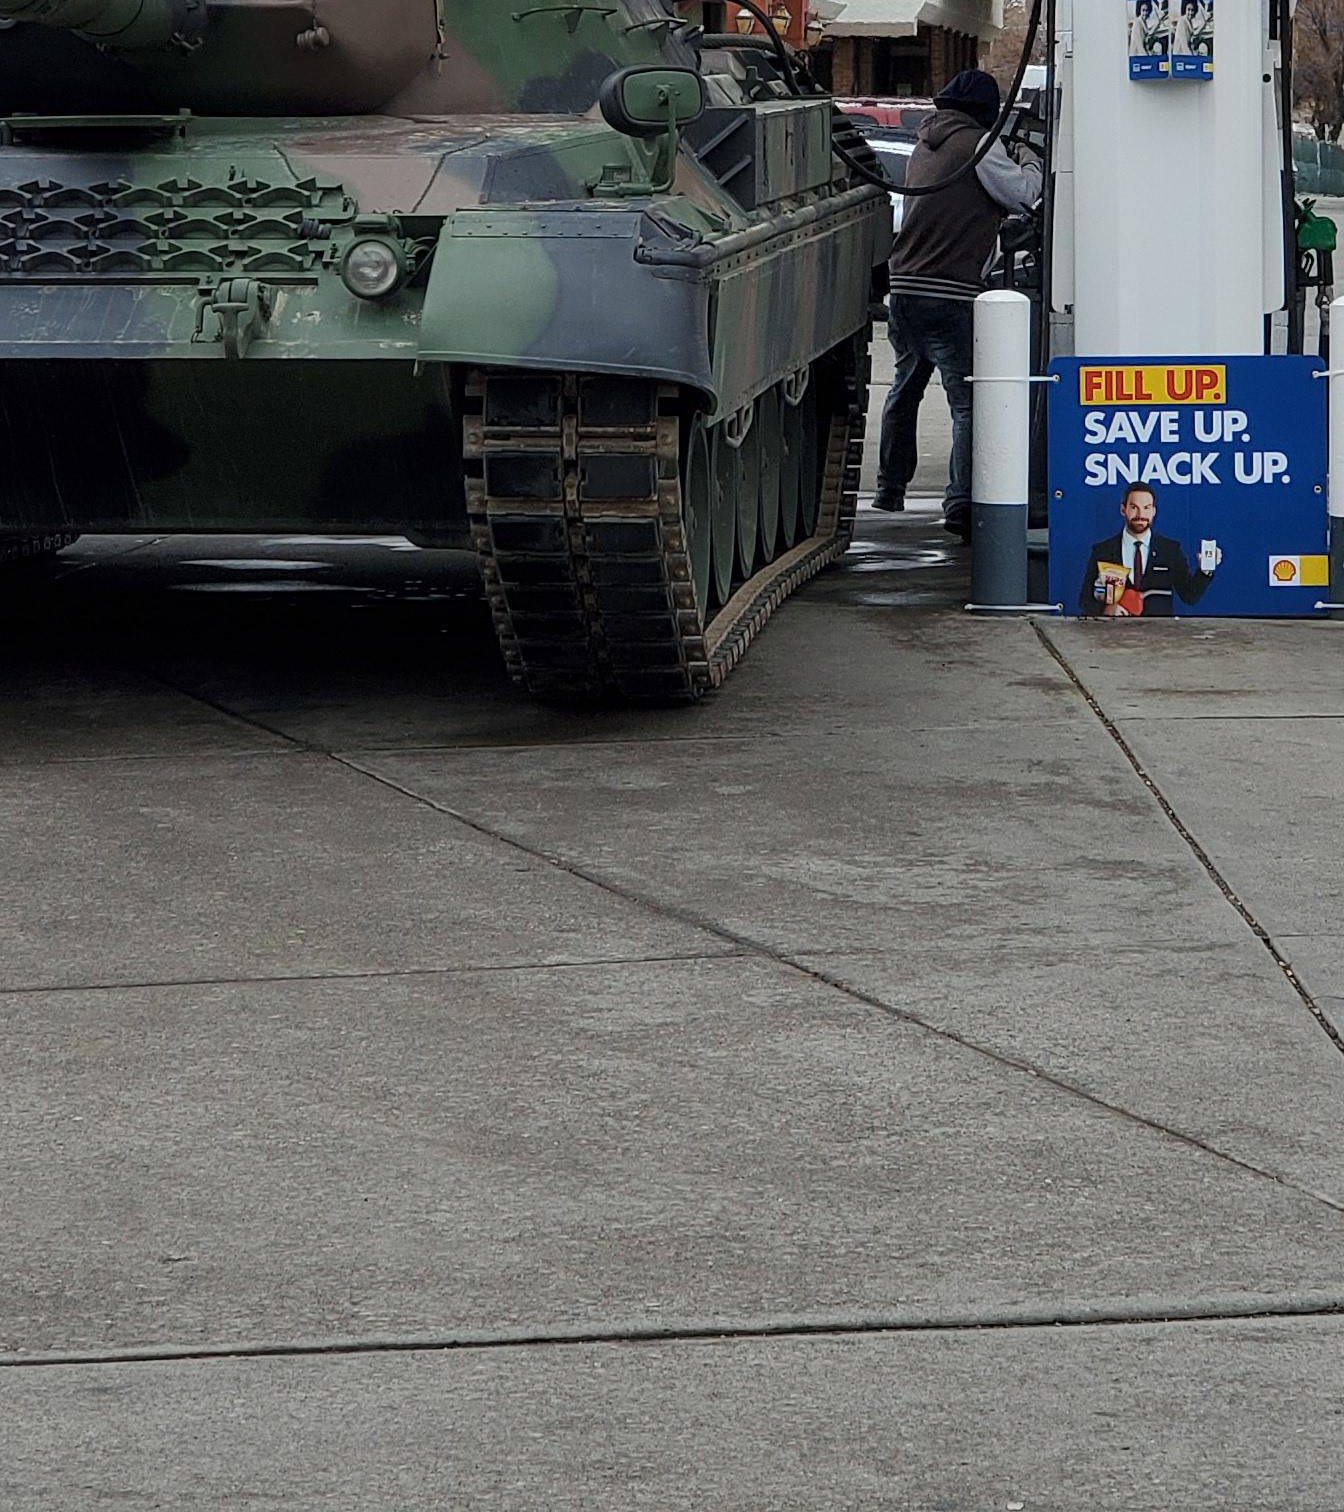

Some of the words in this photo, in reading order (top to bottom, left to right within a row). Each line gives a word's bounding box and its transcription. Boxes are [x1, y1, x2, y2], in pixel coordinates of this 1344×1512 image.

[1084, 369, 1153, 402] FILL
[1166, 369, 1222, 402] UP.
[1084, 410, 1180, 444] SAVE
[1194, 410, 1251, 443] UP.
[1084, 452, 1222, 486] SNACK
[1234, 451, 1291, 485] UP.
